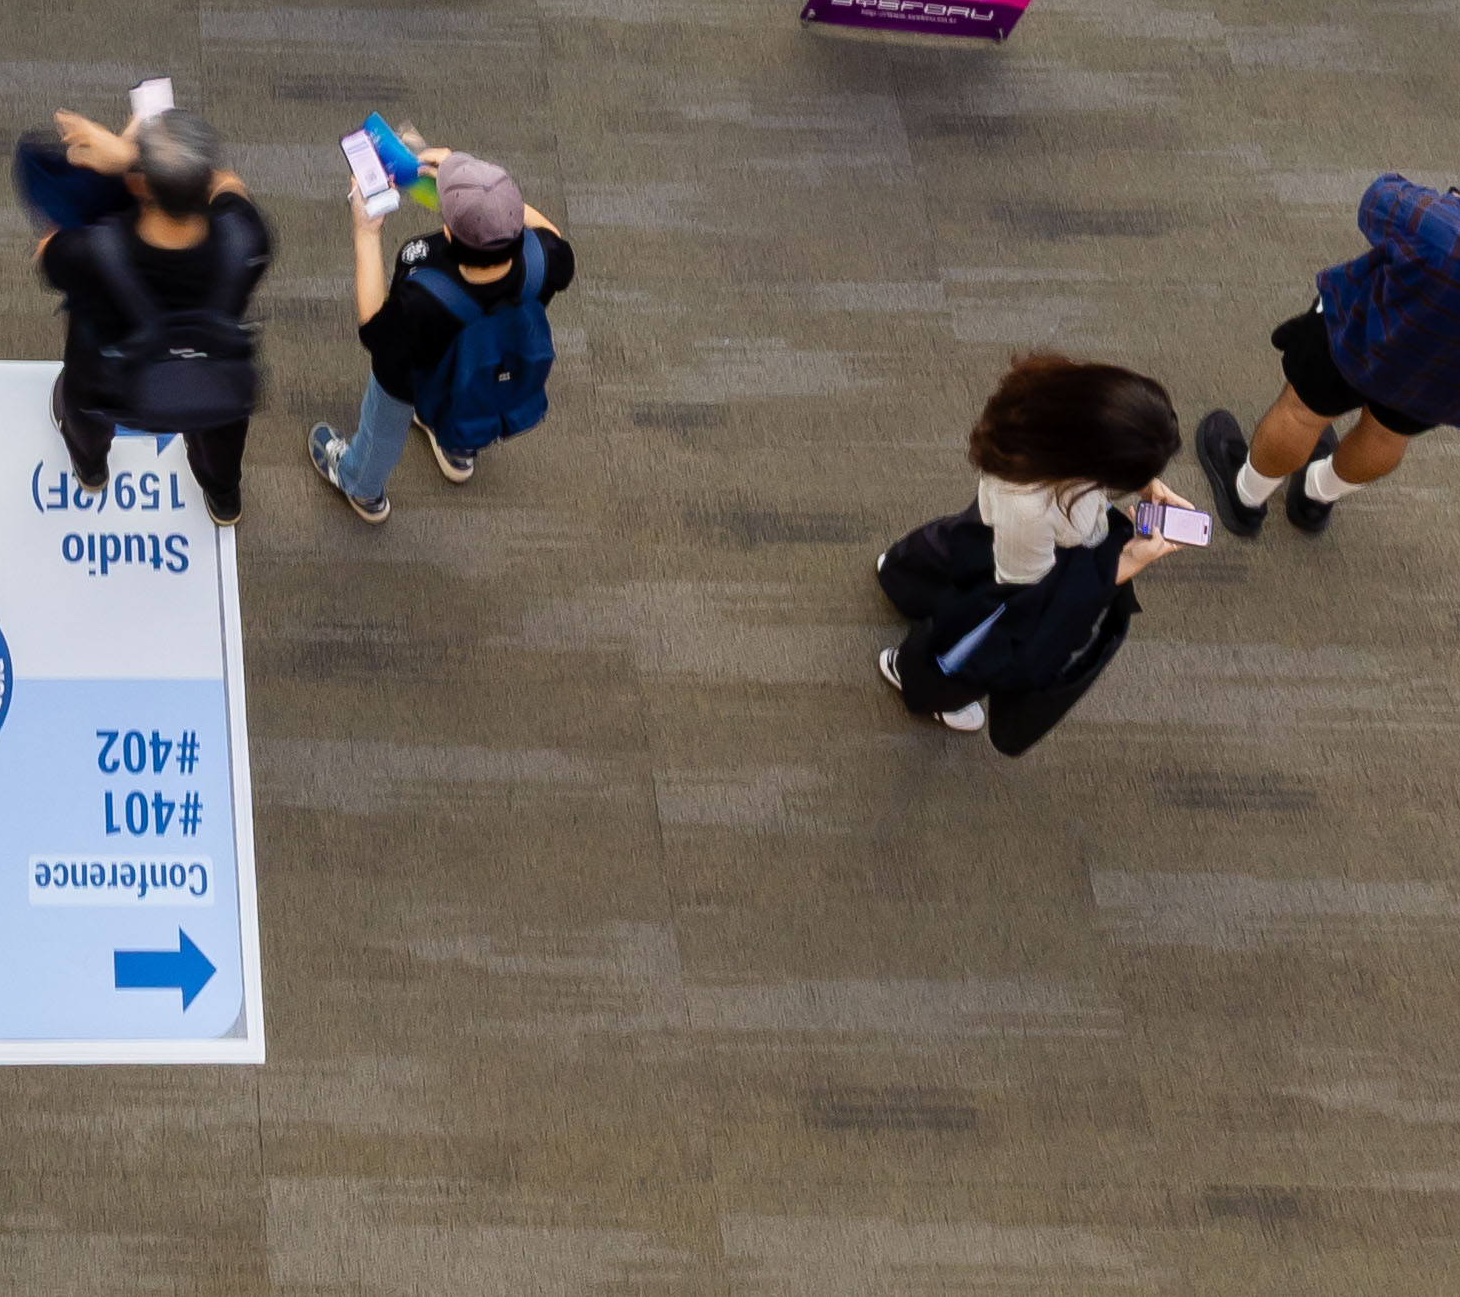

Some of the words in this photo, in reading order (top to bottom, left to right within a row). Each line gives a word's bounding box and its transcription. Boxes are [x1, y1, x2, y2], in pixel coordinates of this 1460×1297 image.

[61, 530, 190, 577] Studio
[96, 730, 201, 776] #402
[103, 791, 204, 838] #401
[34, 862, 210, 898] Conference
